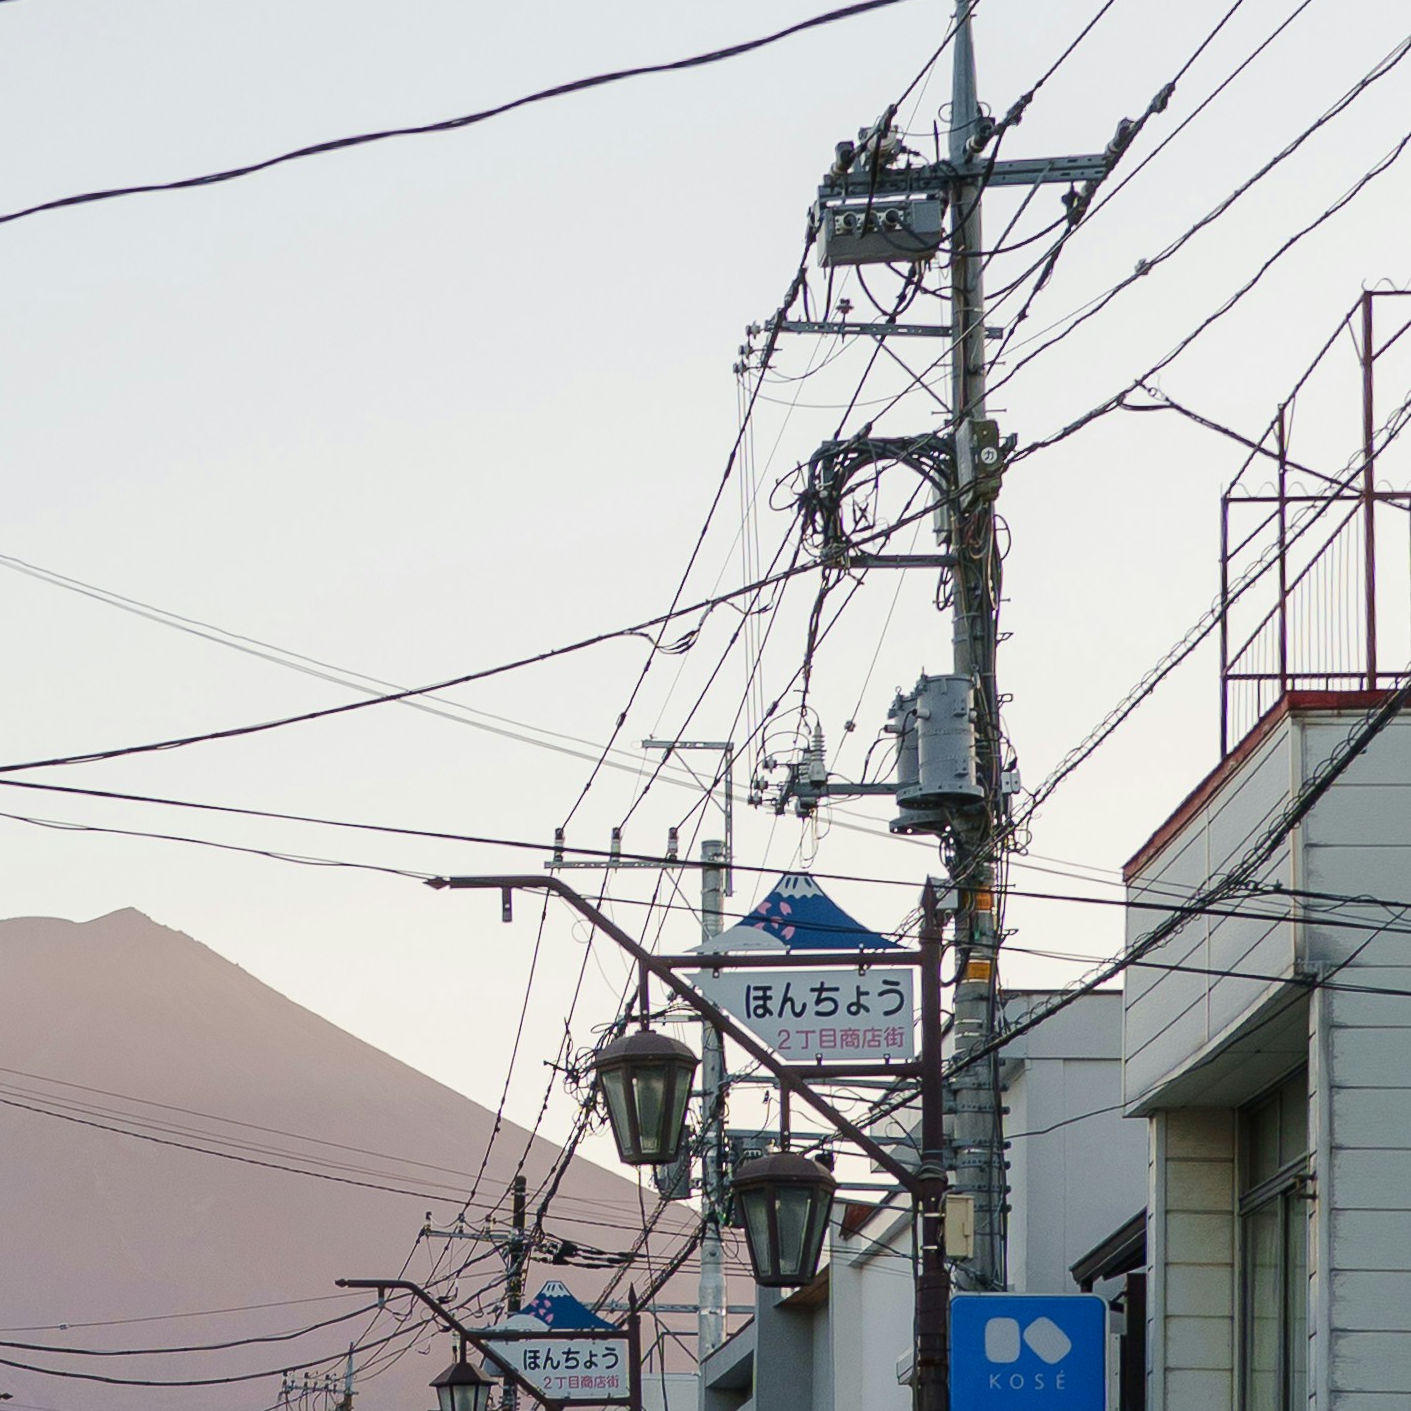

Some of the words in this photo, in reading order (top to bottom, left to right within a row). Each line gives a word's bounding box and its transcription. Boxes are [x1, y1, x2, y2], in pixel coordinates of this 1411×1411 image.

[744, 980, 906, 1021] ほんちょう
[775, 1026, 906, 1051] 2丁目商店街
[521, 1345, 620, 1373] ほんちょう
[542, 1374, 620, 1391] 2丁目商店街
[988, 1369, 1066, 1391] KOSÉ
